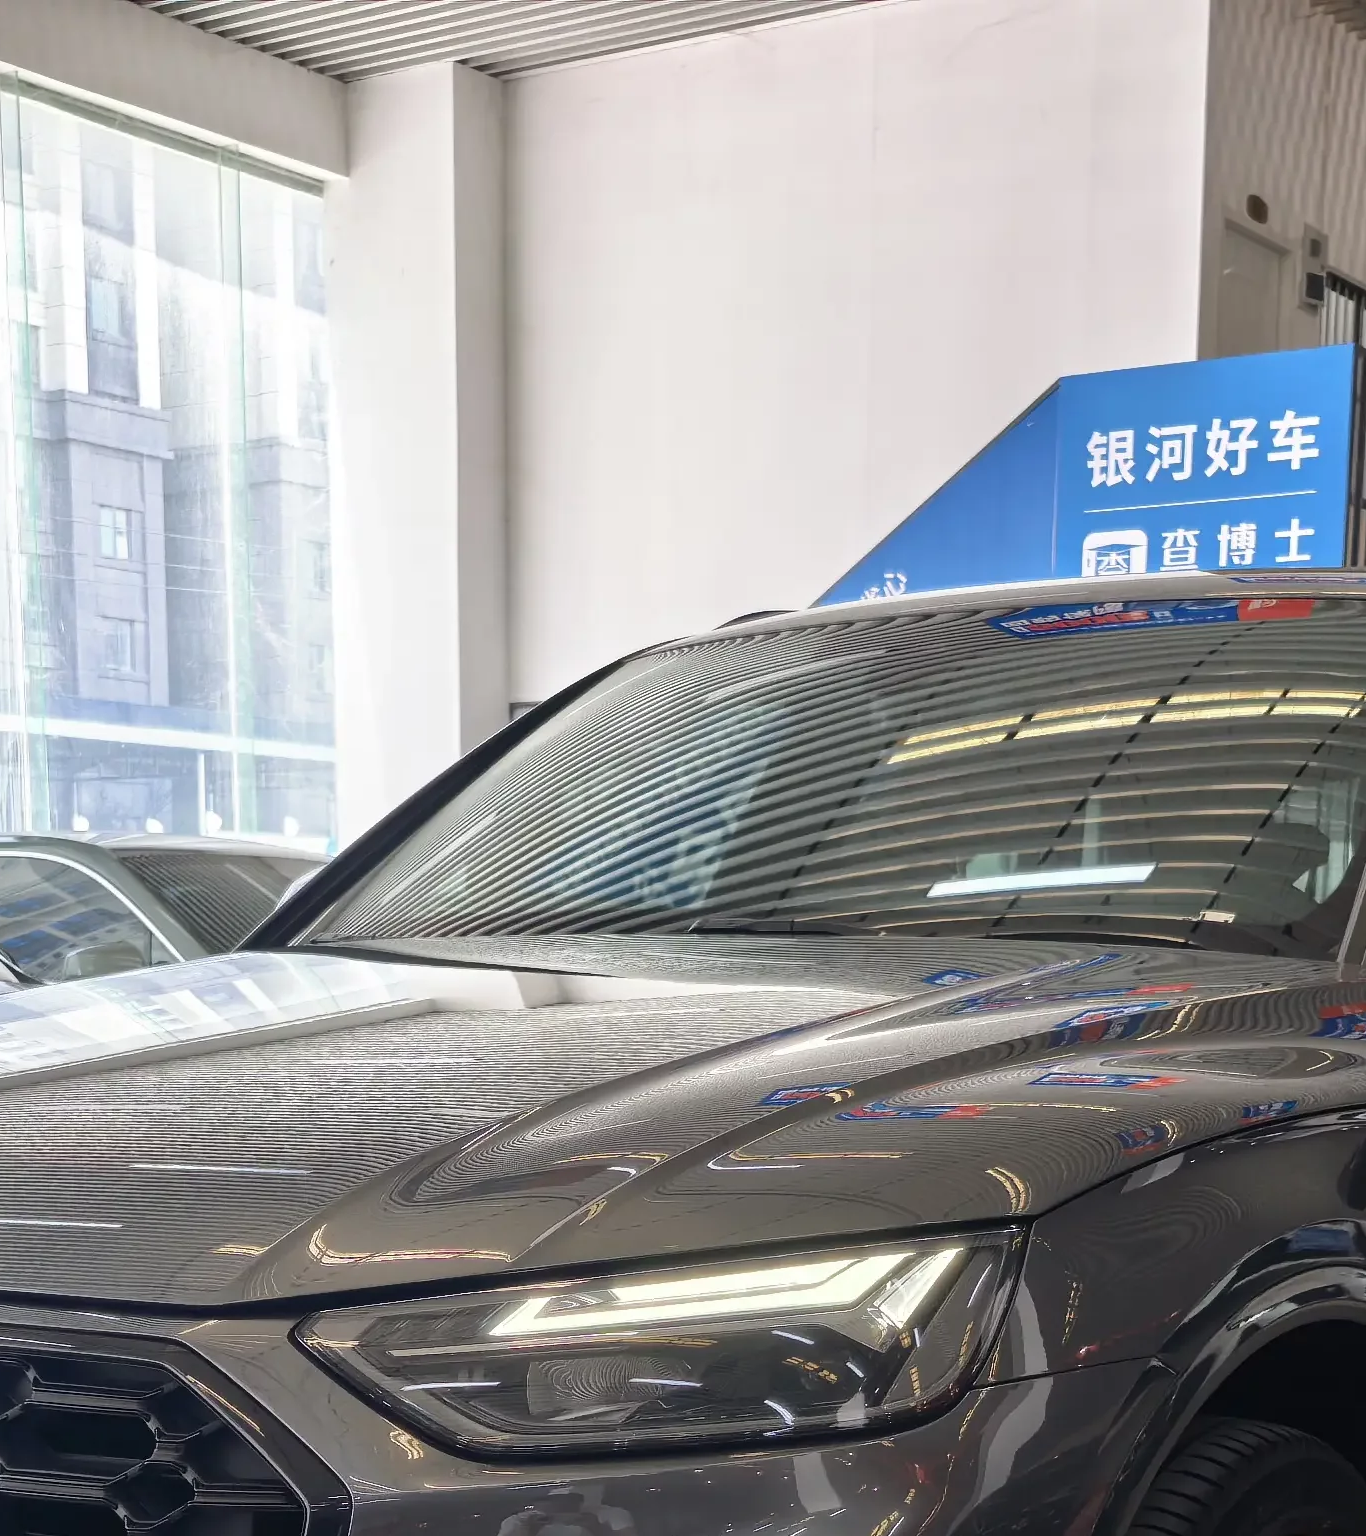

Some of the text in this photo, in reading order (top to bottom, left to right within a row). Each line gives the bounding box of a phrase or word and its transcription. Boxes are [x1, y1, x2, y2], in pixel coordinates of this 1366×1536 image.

[1086, 409, 1320, 488] 银河好车
[1159, 518, 1316, 572] 查博士
